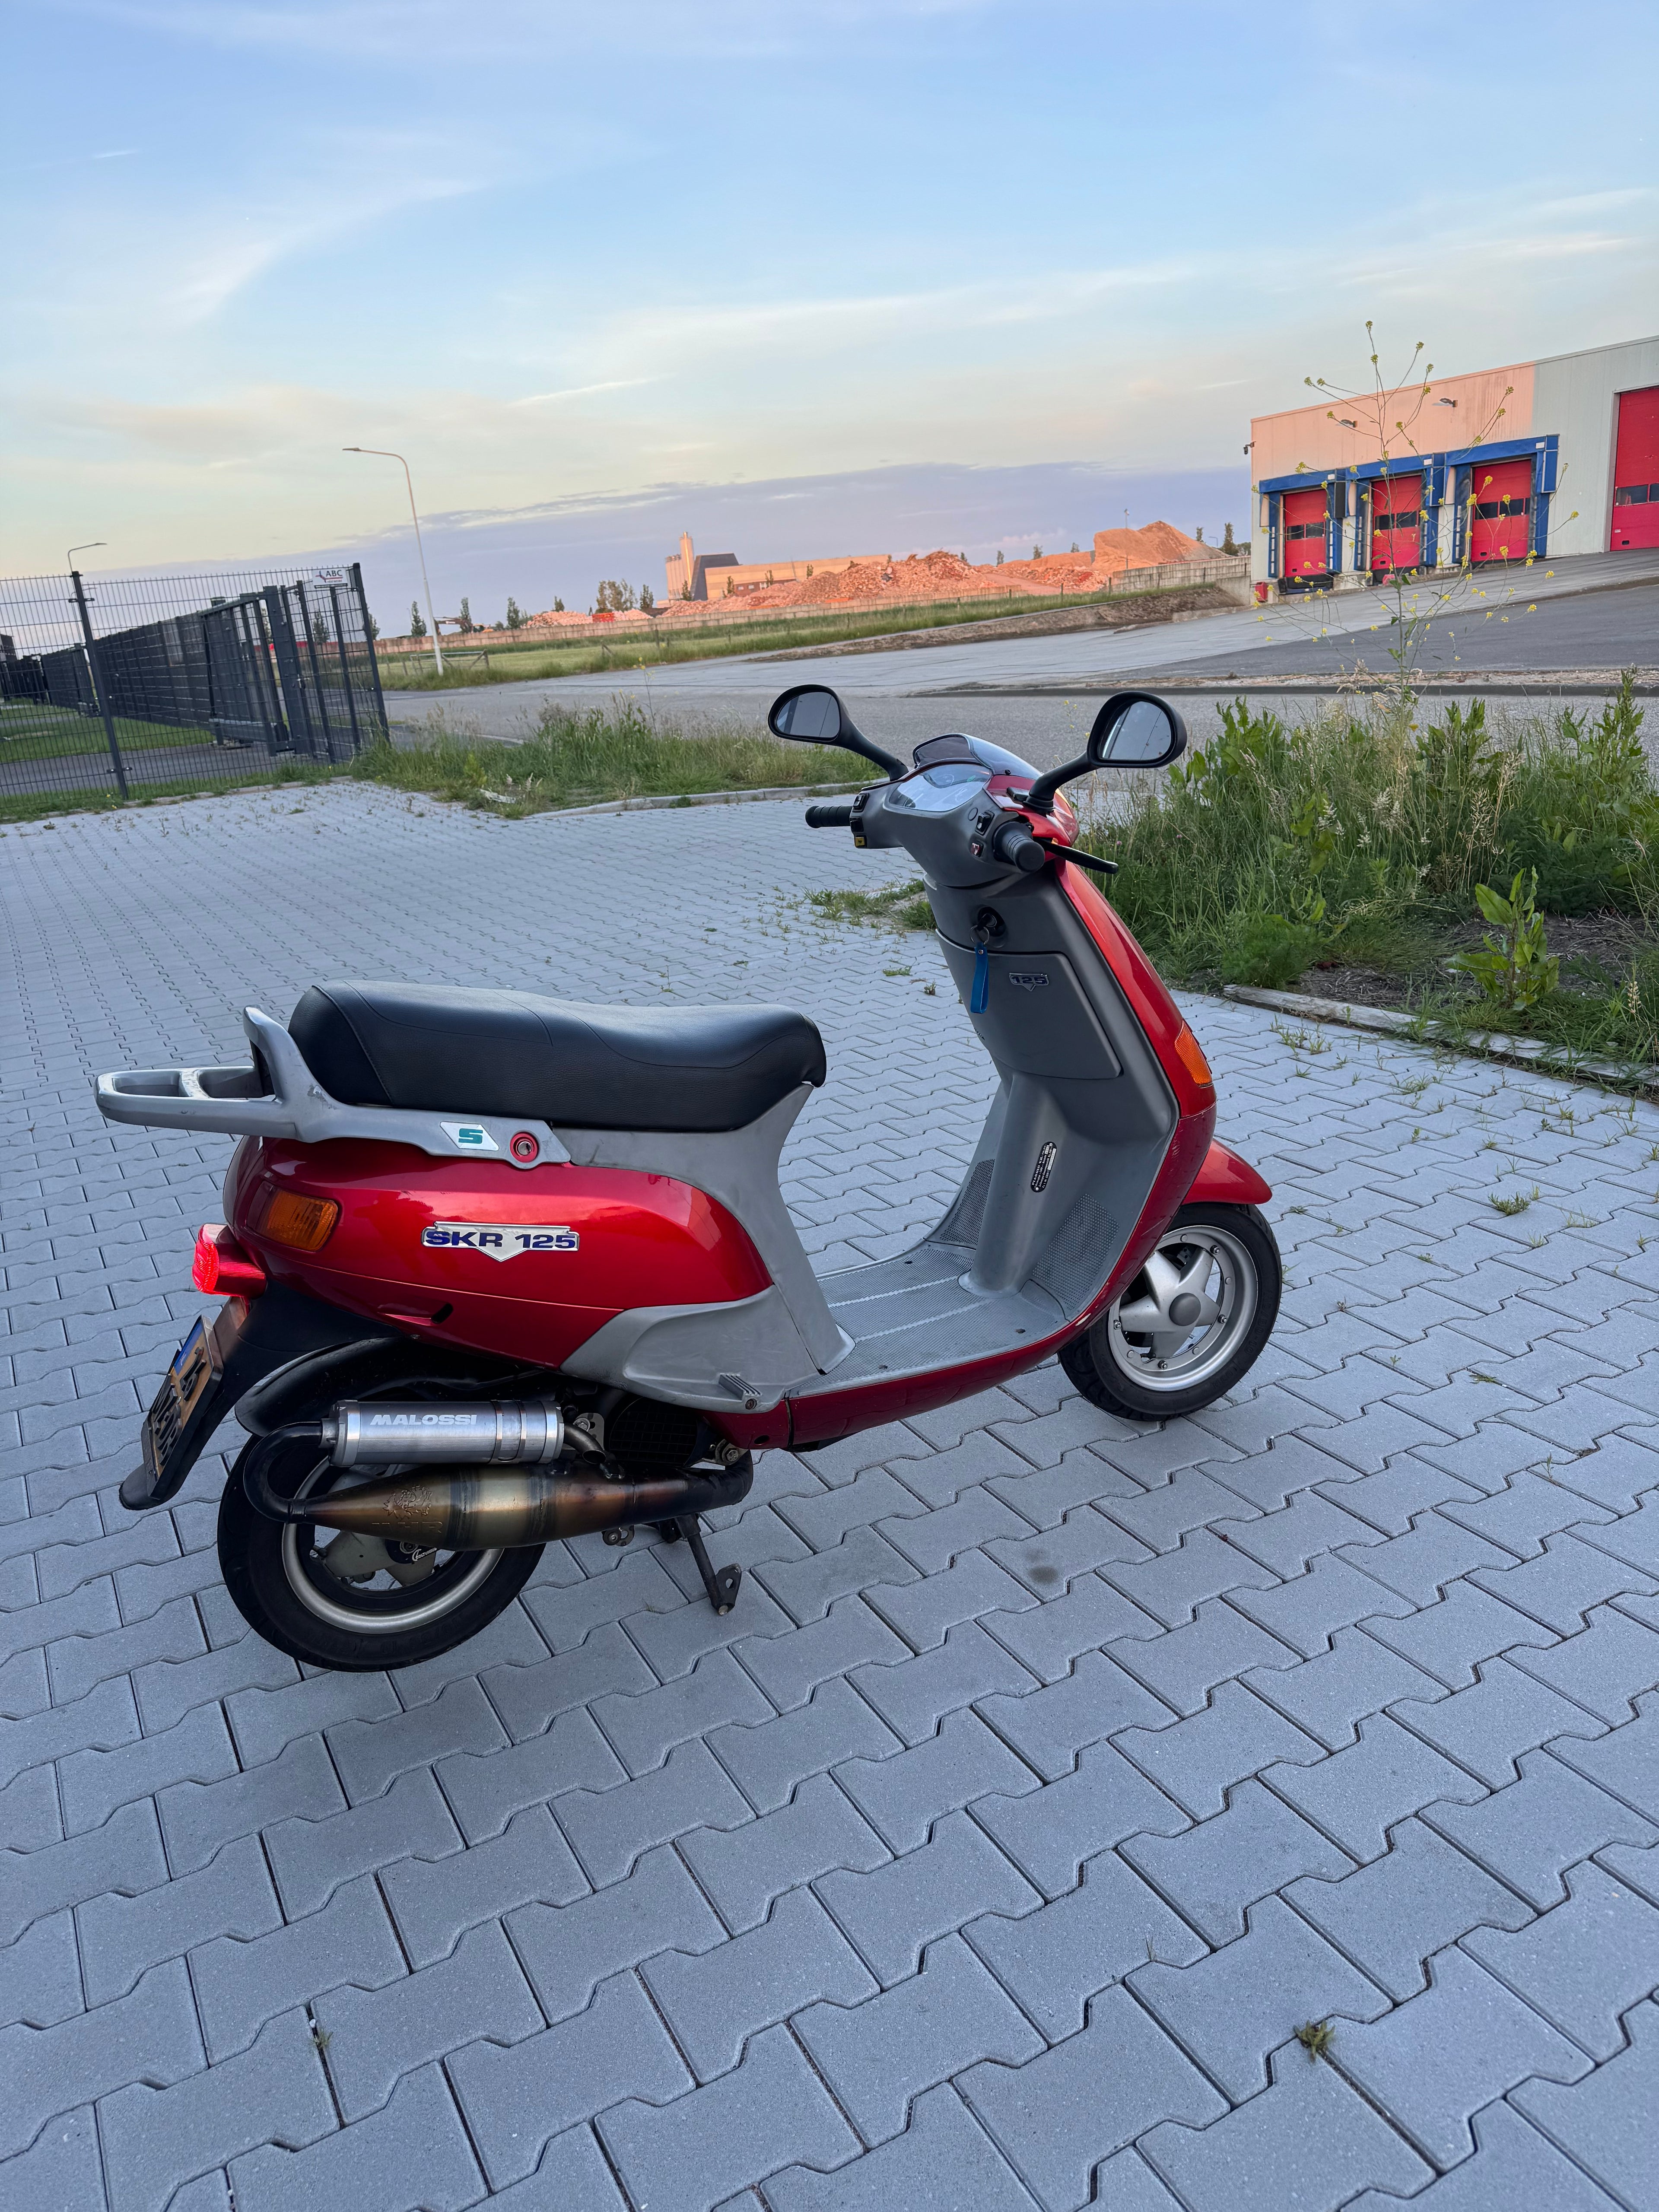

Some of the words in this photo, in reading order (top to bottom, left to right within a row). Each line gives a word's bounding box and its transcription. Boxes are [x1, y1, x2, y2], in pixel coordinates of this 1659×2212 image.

[1011, 976, 1047, 984] 125
[458, 1128, 483, 1144] S
[426, 1231, 503, 1247] SKR
[515, 1234, 575, 1249] 125
[180, 1347, 207, 1402] 26
[370, 1414, 477, 1425] MALOSSI
